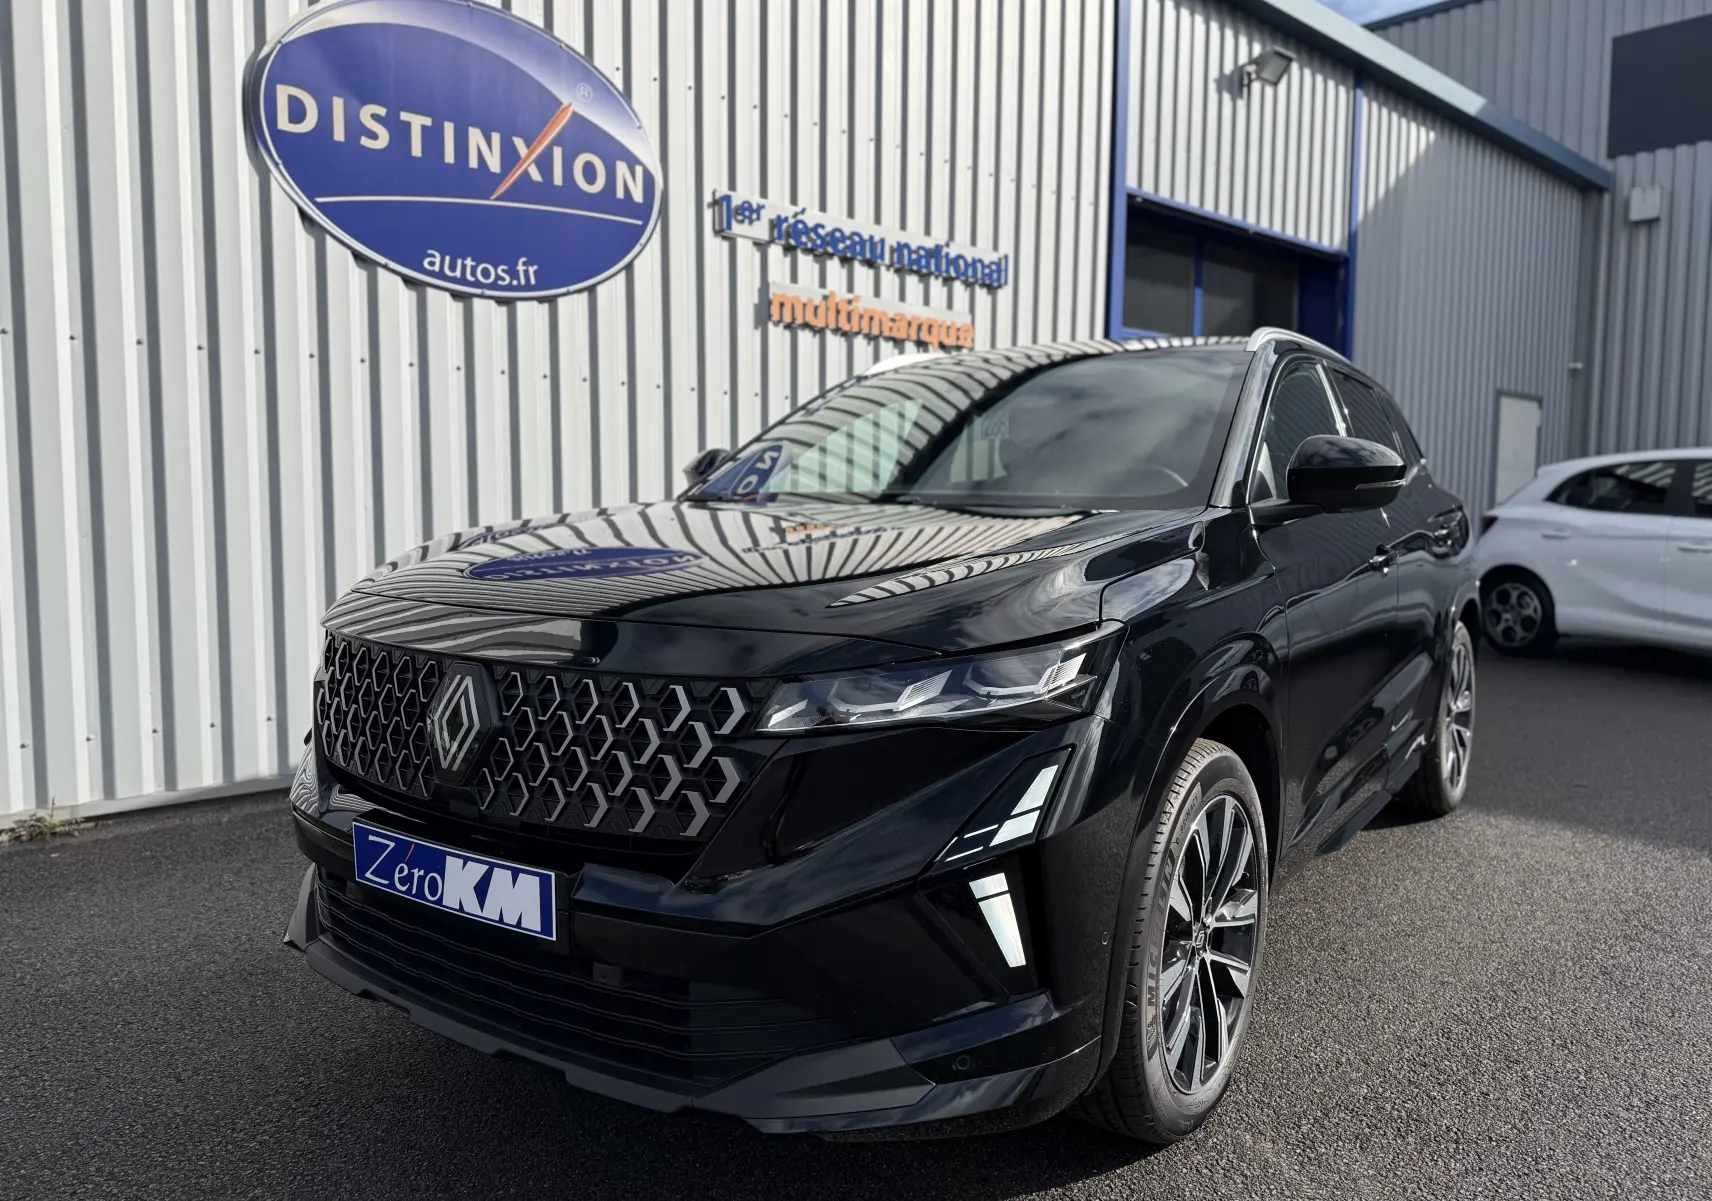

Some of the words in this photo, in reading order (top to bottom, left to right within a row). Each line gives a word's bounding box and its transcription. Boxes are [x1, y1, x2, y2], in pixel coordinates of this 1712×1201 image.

[276, 84, 644, 204] DISTINXION
[422, 249, 538, 287] autos.fr
[717, 194, 765, 232] 1er
[775, 207, 885, 262] réseau
[896, 241, 1009, 286] national
[771, 290, 975, 353] multimarque
